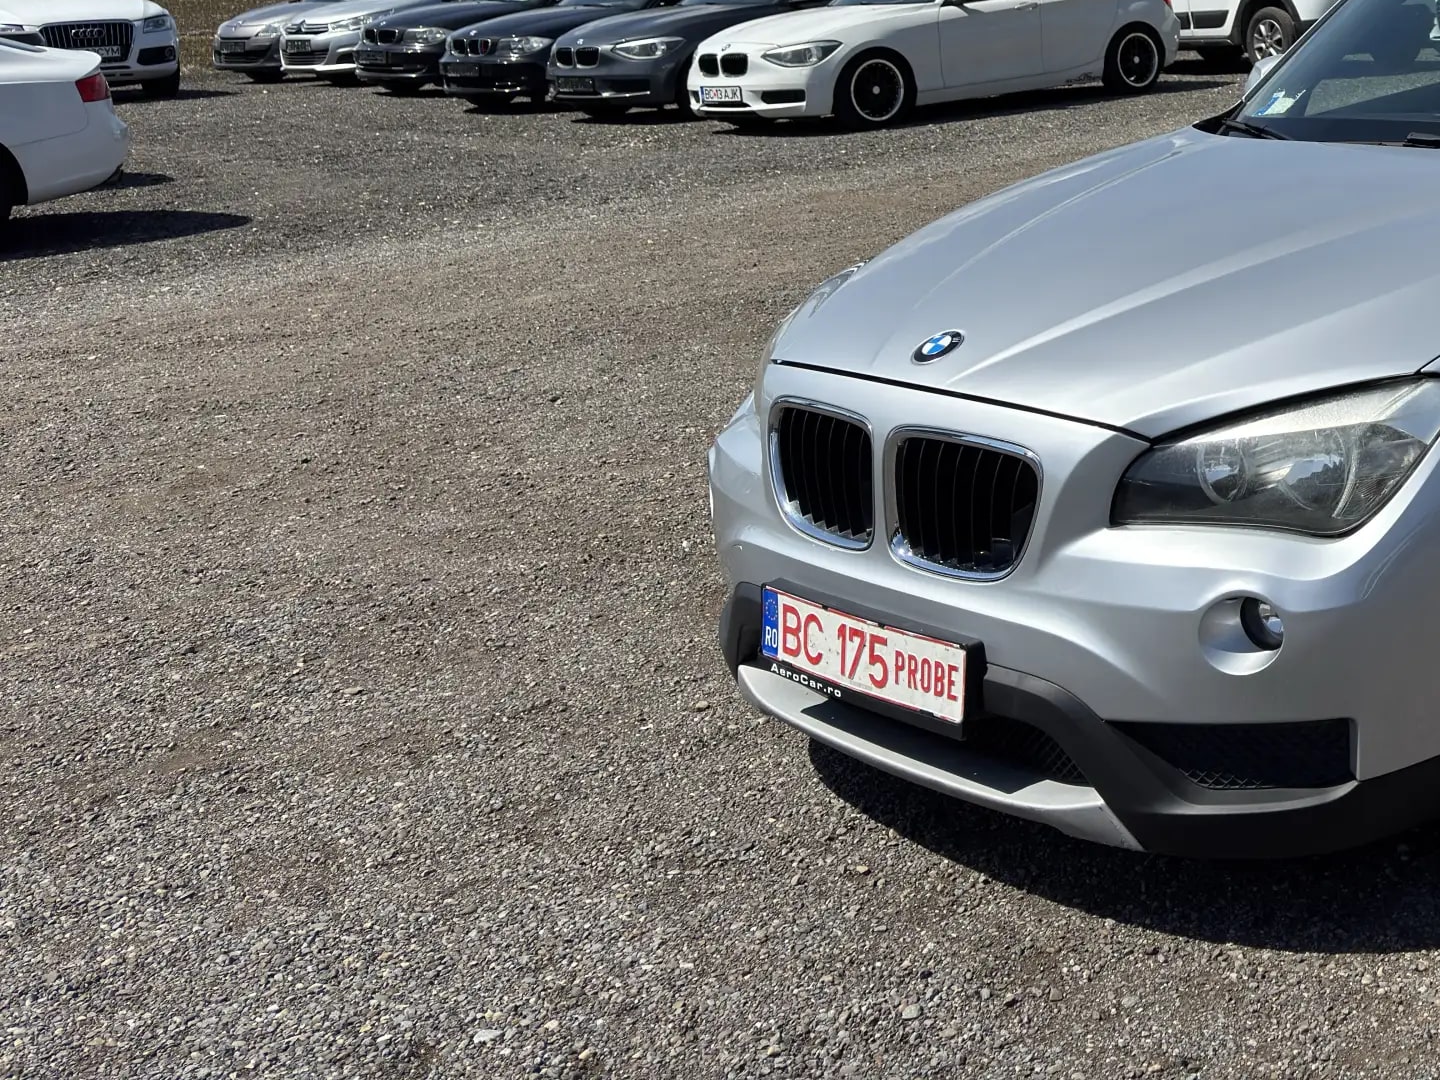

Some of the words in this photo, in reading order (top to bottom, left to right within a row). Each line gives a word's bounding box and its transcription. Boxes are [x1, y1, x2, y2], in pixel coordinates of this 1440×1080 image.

[765, 626, 778, 648] RO
[782, 603, 824, 665] BC
[837, 623, 889, 689] 175
[894, 650, 960, 701] PROBE
[771, 663, 842, 697] AeroCar.ro
